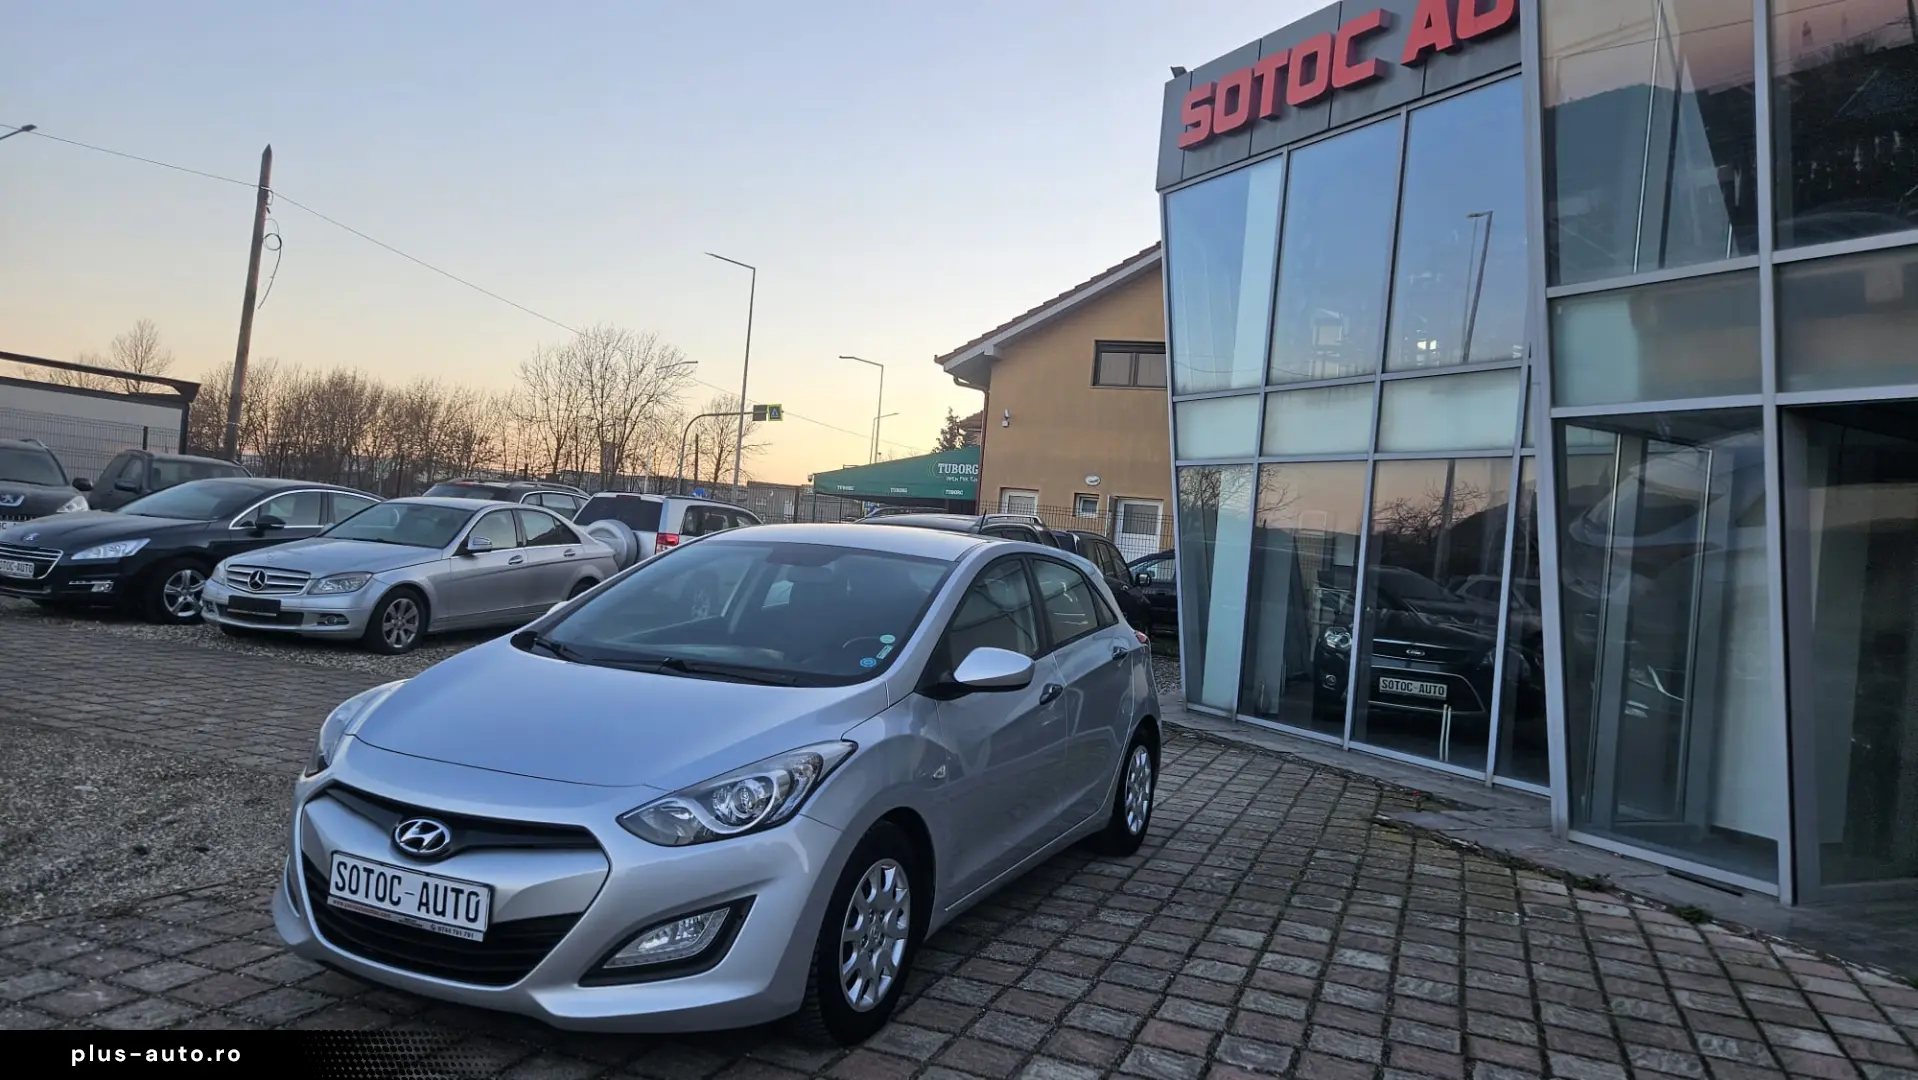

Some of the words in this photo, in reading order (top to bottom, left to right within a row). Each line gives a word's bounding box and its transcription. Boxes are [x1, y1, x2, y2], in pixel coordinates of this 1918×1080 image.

[1177, 8, 1391, 150] SOTOC
[937, 462, 979, 475] TUBORG
[1381, 678, 1445, 696] SOTOC-AUTO
[334, 860, 481, 924] SOTOC-AUTO
